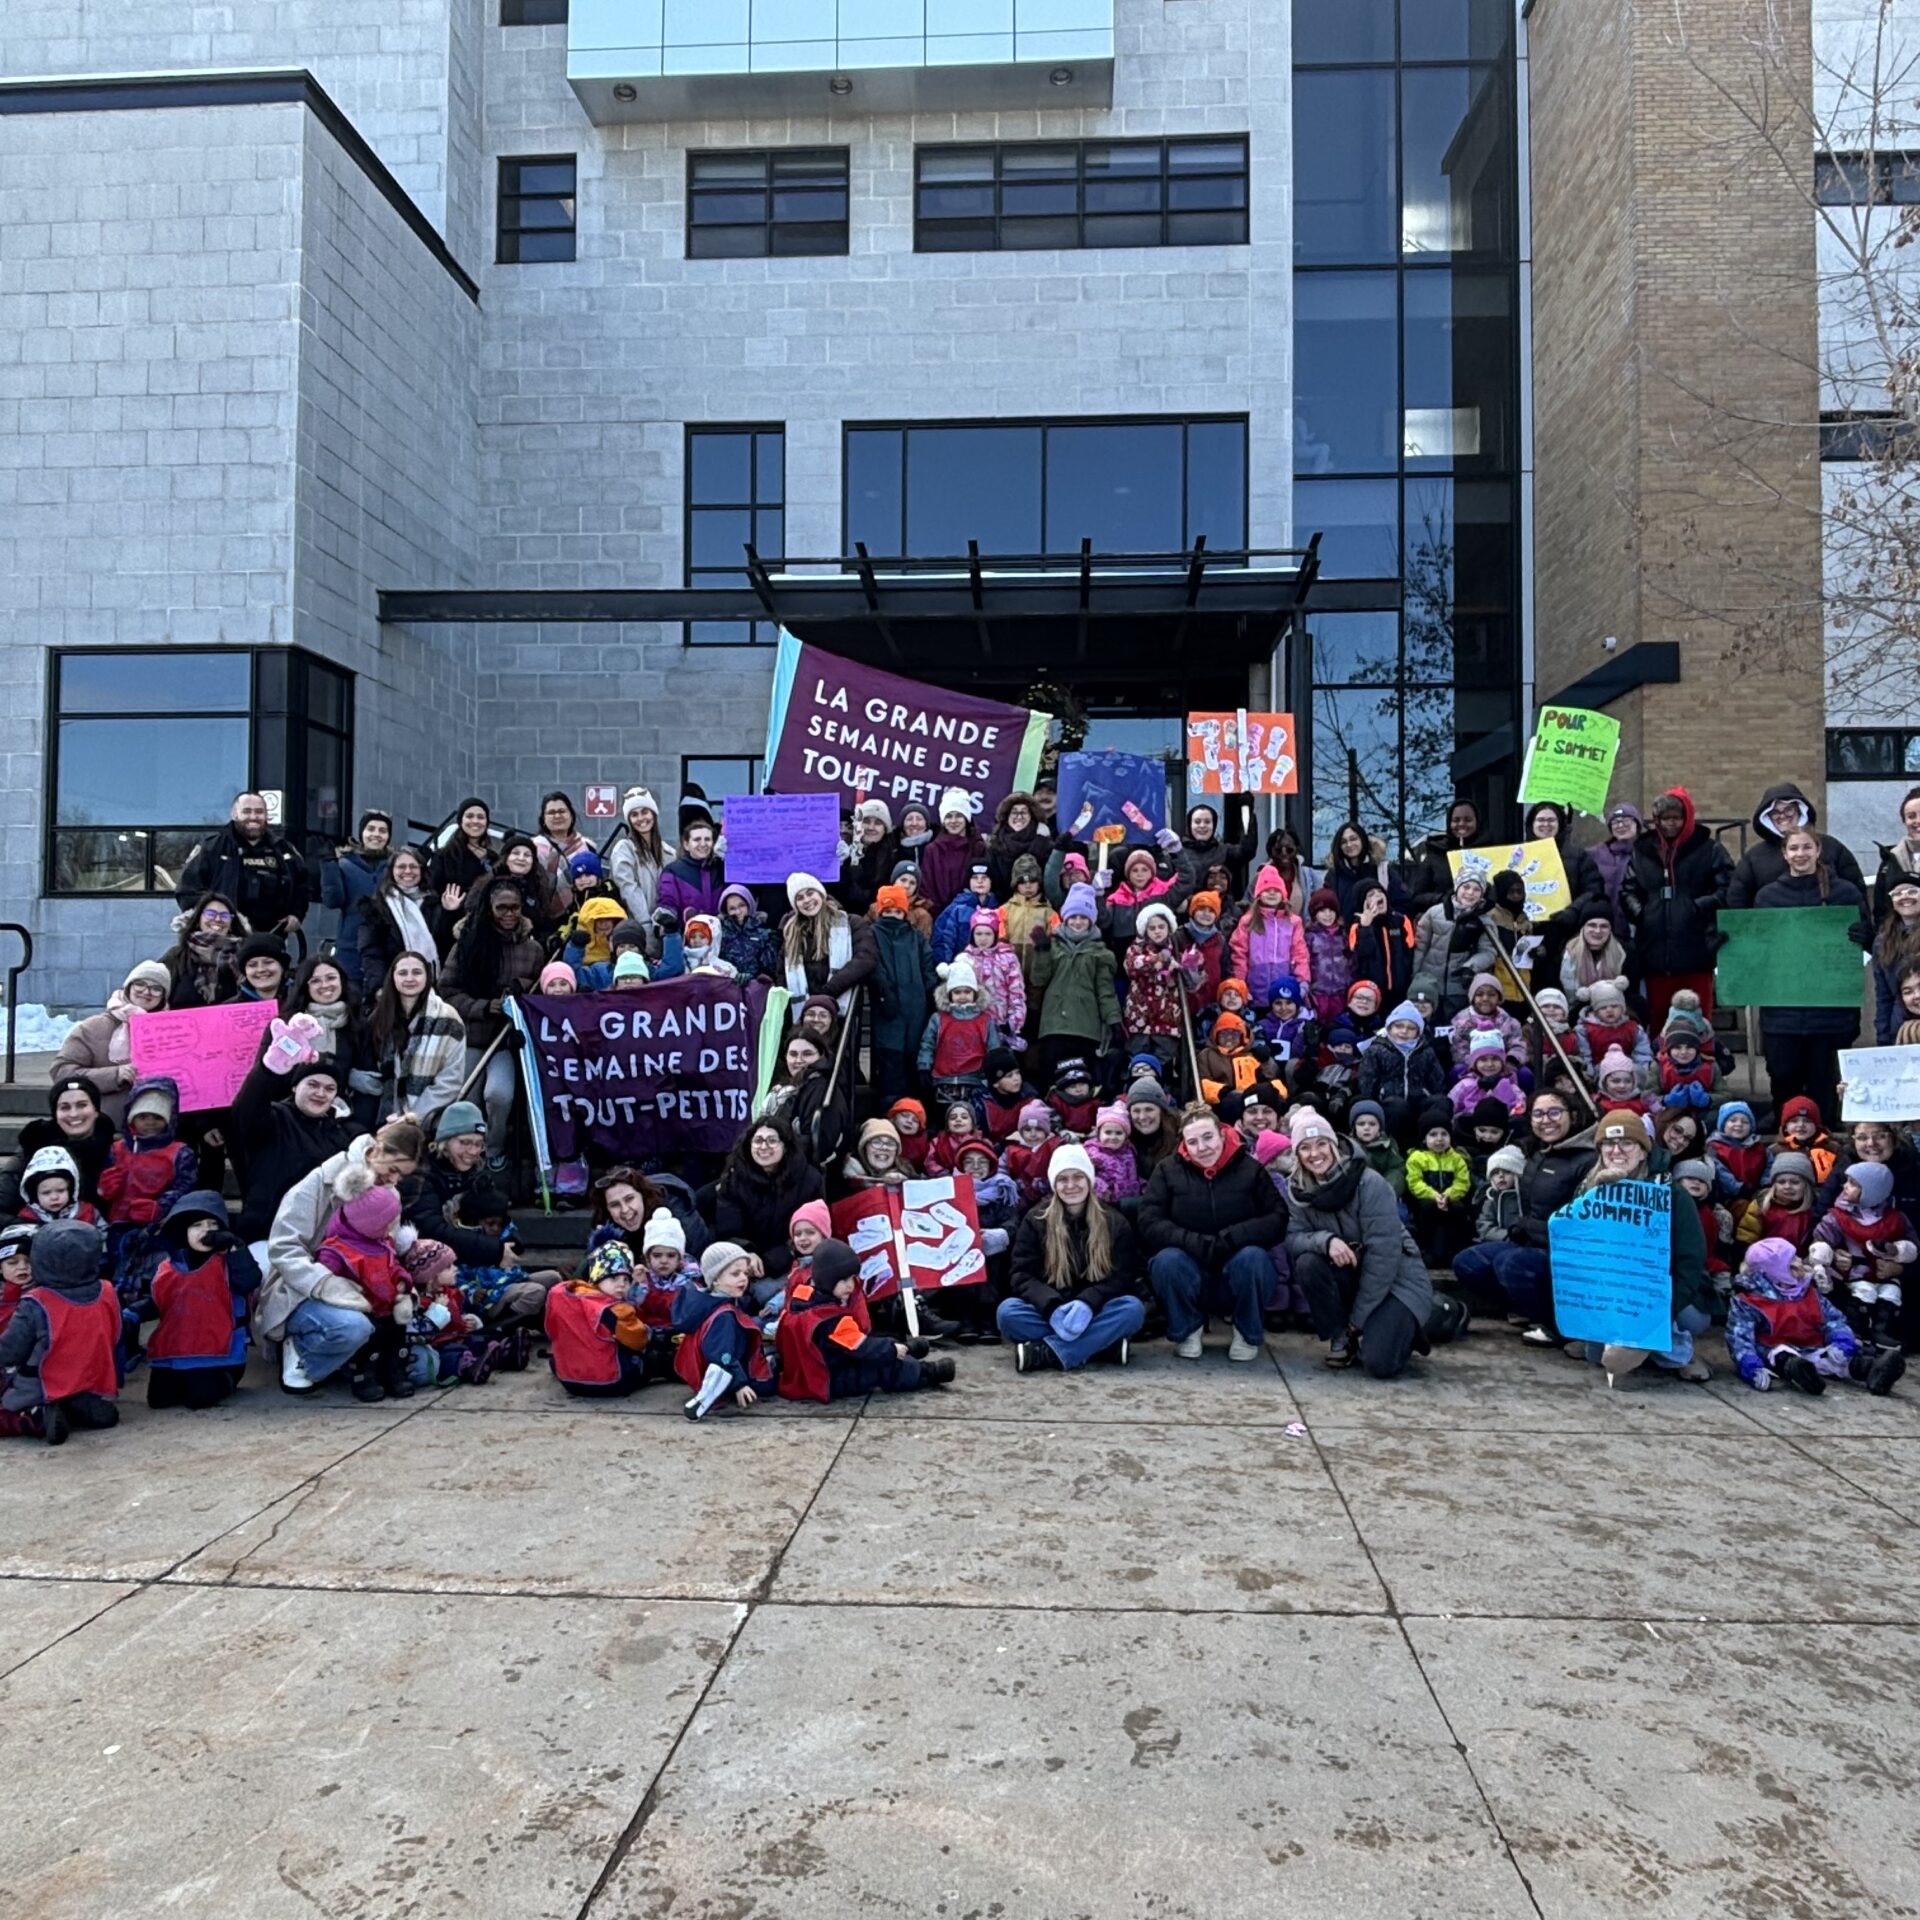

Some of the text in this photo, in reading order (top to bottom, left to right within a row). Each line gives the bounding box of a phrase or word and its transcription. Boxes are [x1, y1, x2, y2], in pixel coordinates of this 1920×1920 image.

[814, 679, 999, 749] LA GRANDE
[1544, 710, 1587, 731] POUR
[807, 715, 991, 779] SEMAINE DES
[1553, 739, 1608, 763] SOMMET
[803, 748, 985, 815] TOUT-PETS
[540, 1015, 580, 1045] LA
[546, 1045, 749, 1082] SEMAINE DES
[552, 1088, 749, 1128] TOUT-PETITS
[1578, 1199, 1653, 1227] SOMMET
